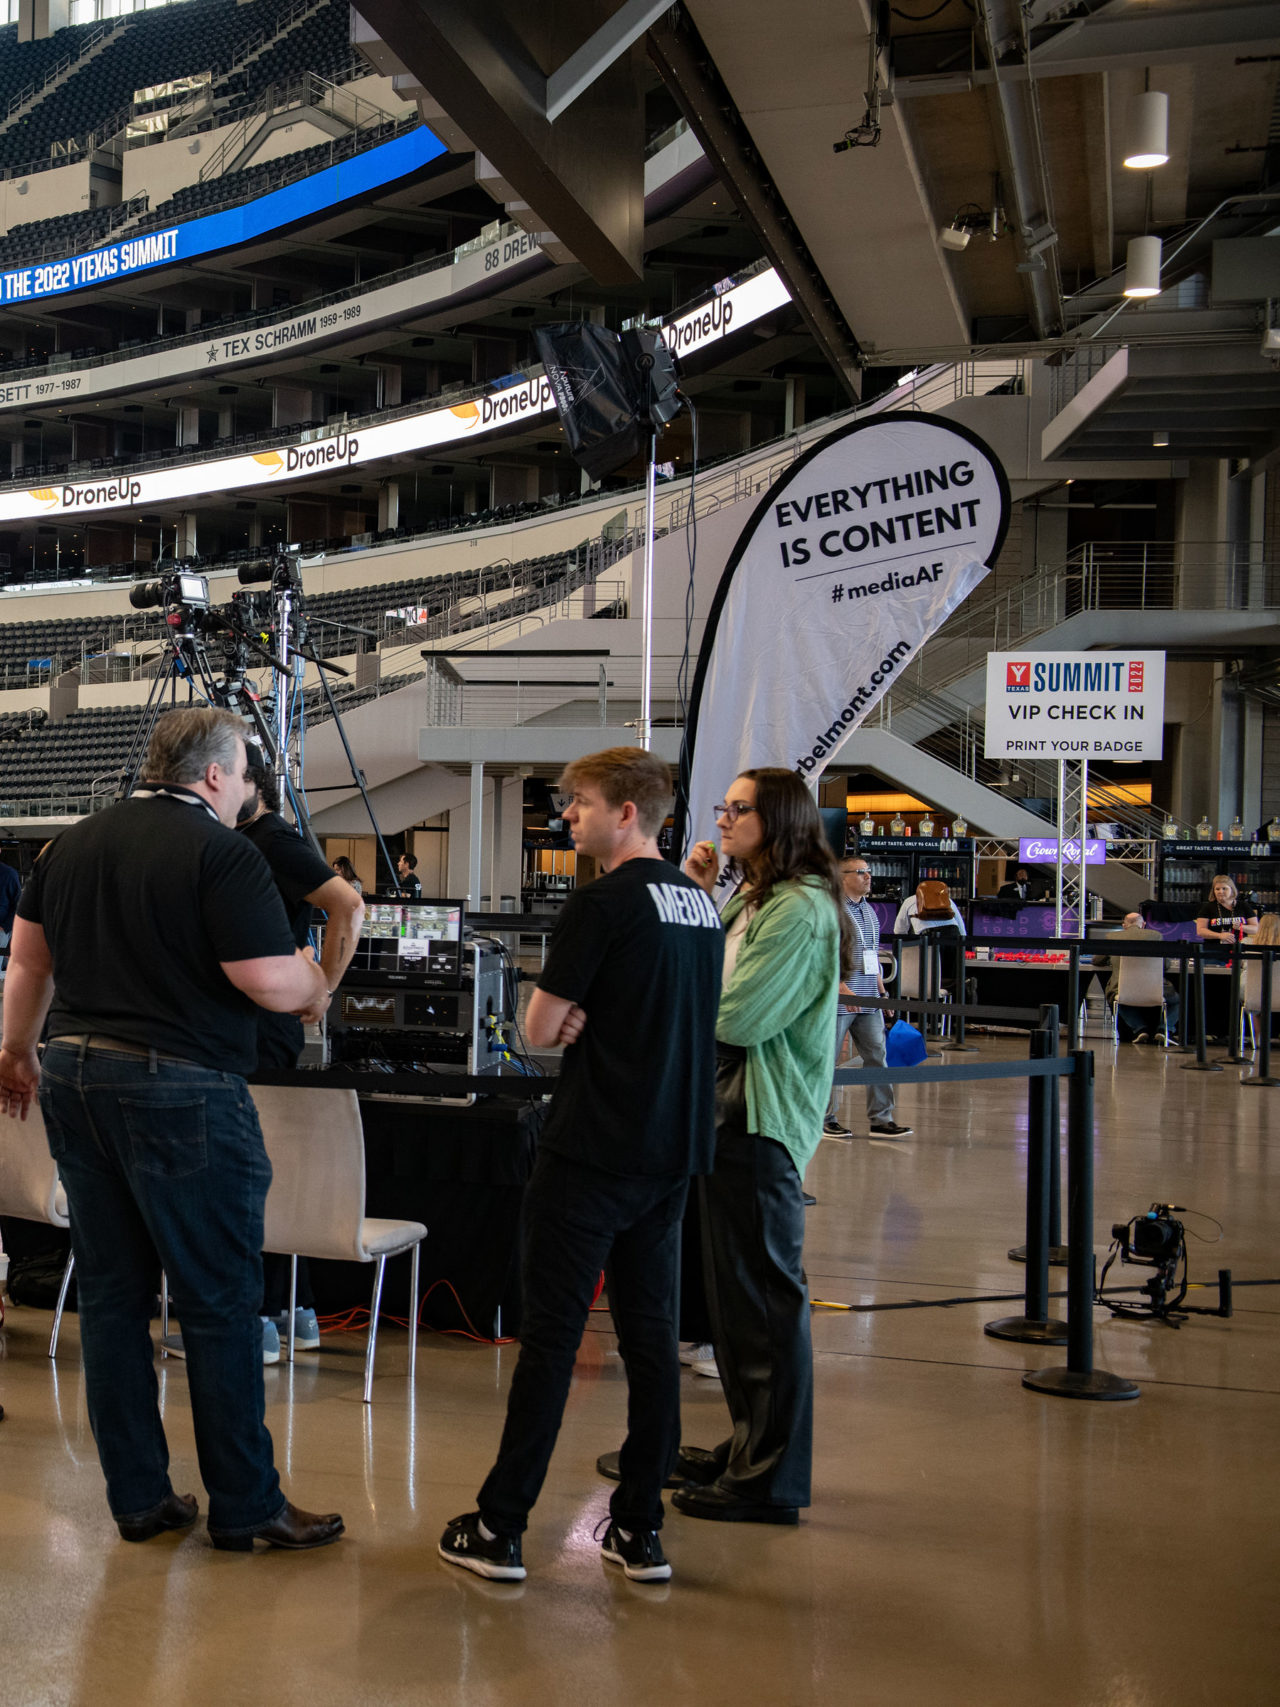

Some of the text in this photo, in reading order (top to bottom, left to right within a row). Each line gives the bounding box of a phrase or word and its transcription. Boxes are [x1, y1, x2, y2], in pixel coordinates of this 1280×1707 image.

[5, 271, 32, 299] THE
[34, 263, 70, 293] 2022
[72, 249, 118, 284] YTEXAS
[121, 230, 178, 270] SUMMIT
[485, 248, 499, 271] 88
[223, 305, 361, 358] TEX SCHRAMM 1959-1989
[669, 295, 733, 353] DroneUp
[35, 378, 81, 396] 1977-1987
[481, 375, 551, 424] DroneUp
[287, 433, 359, 472] DroneUp
[62, 477, 141, 505] DroneUp
[775, 460, 974, 528] EVERYTHING
[780, 499, 981, 568] IS CONTENT
[832, 563, 944, 603] #mediaAF
[1034, 662, 1125, 692] SUMMIT
[1130, 663, 1143, 691] 2022
[795, 640, 912, 780] rbelmont.com
[1008, 705, 1145, 720] VIP CHECK IN
[1006, 740, 1143, 752] PRINT YOUR BADGE
[646, 882, 721, 930] MEDIA
